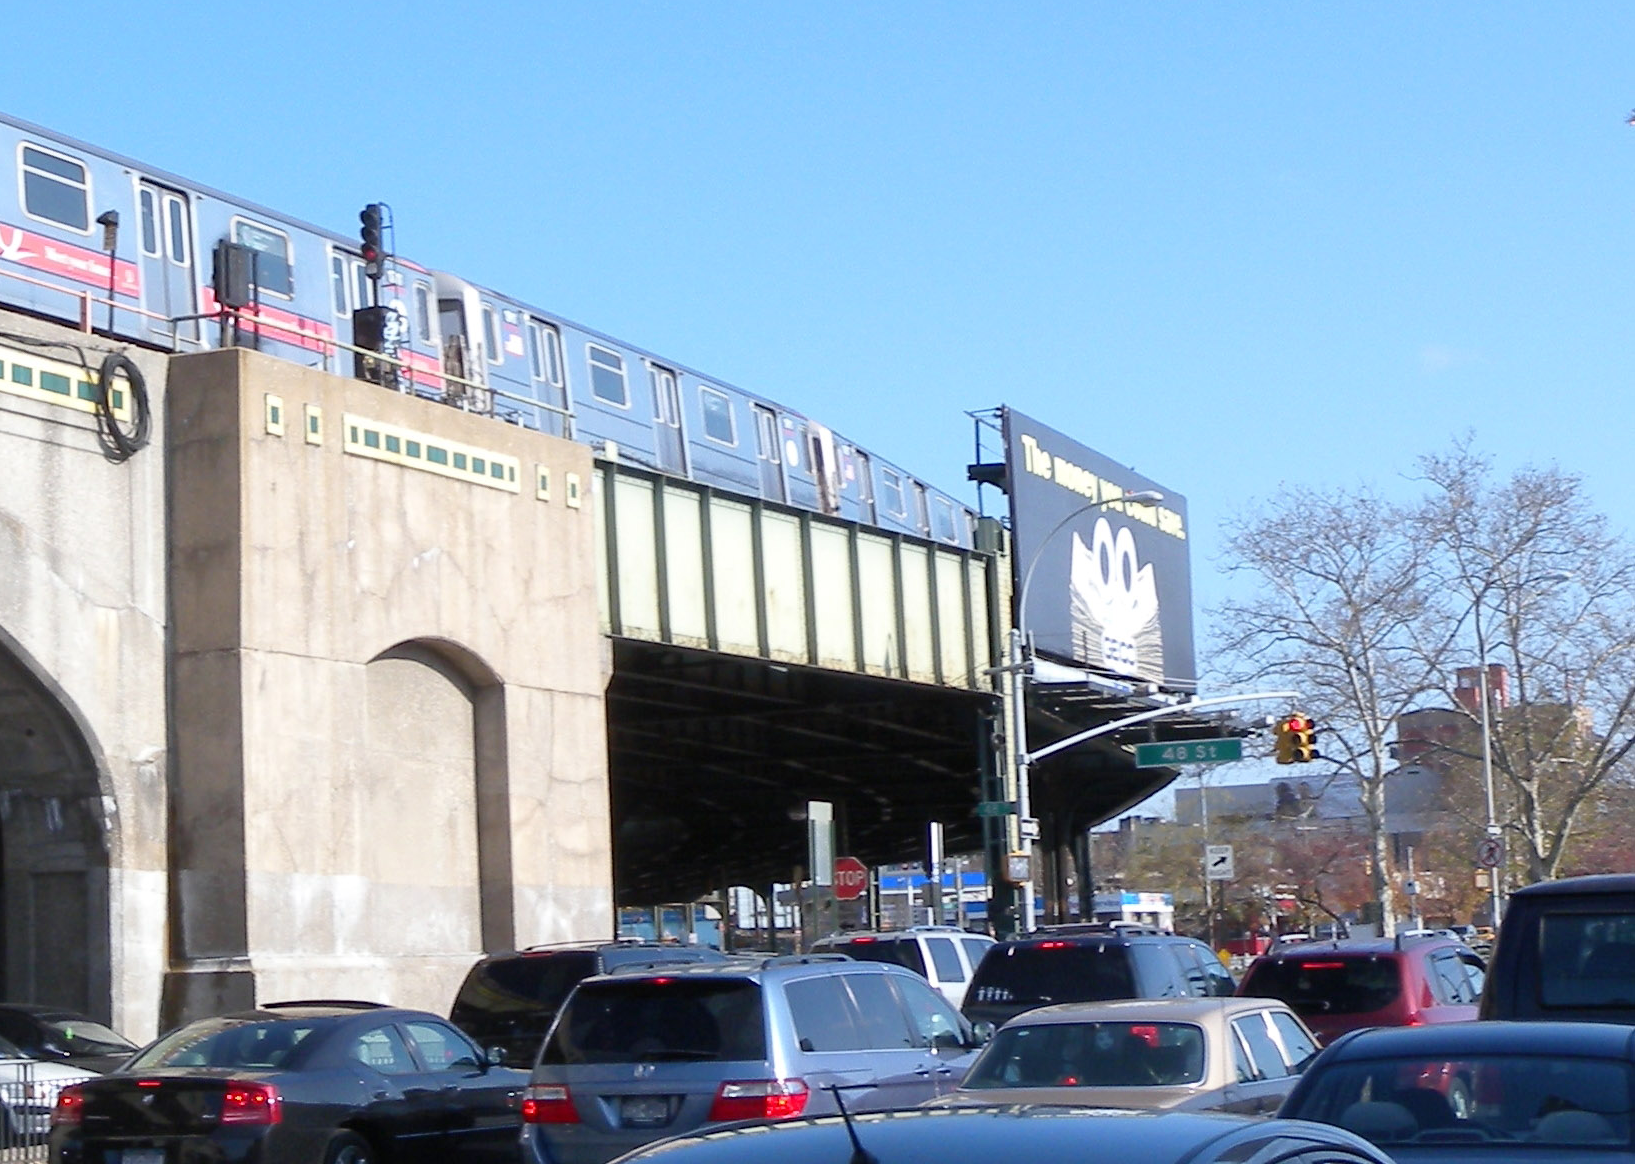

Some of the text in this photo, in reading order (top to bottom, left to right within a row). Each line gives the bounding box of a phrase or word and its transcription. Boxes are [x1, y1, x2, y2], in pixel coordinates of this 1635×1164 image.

[1021, 434, 1052, 480] The
[1053, 456, 1099, 504] money
[1099, 478, 1124, 512] you
[1161, 745, 1217, 760] 48 St
